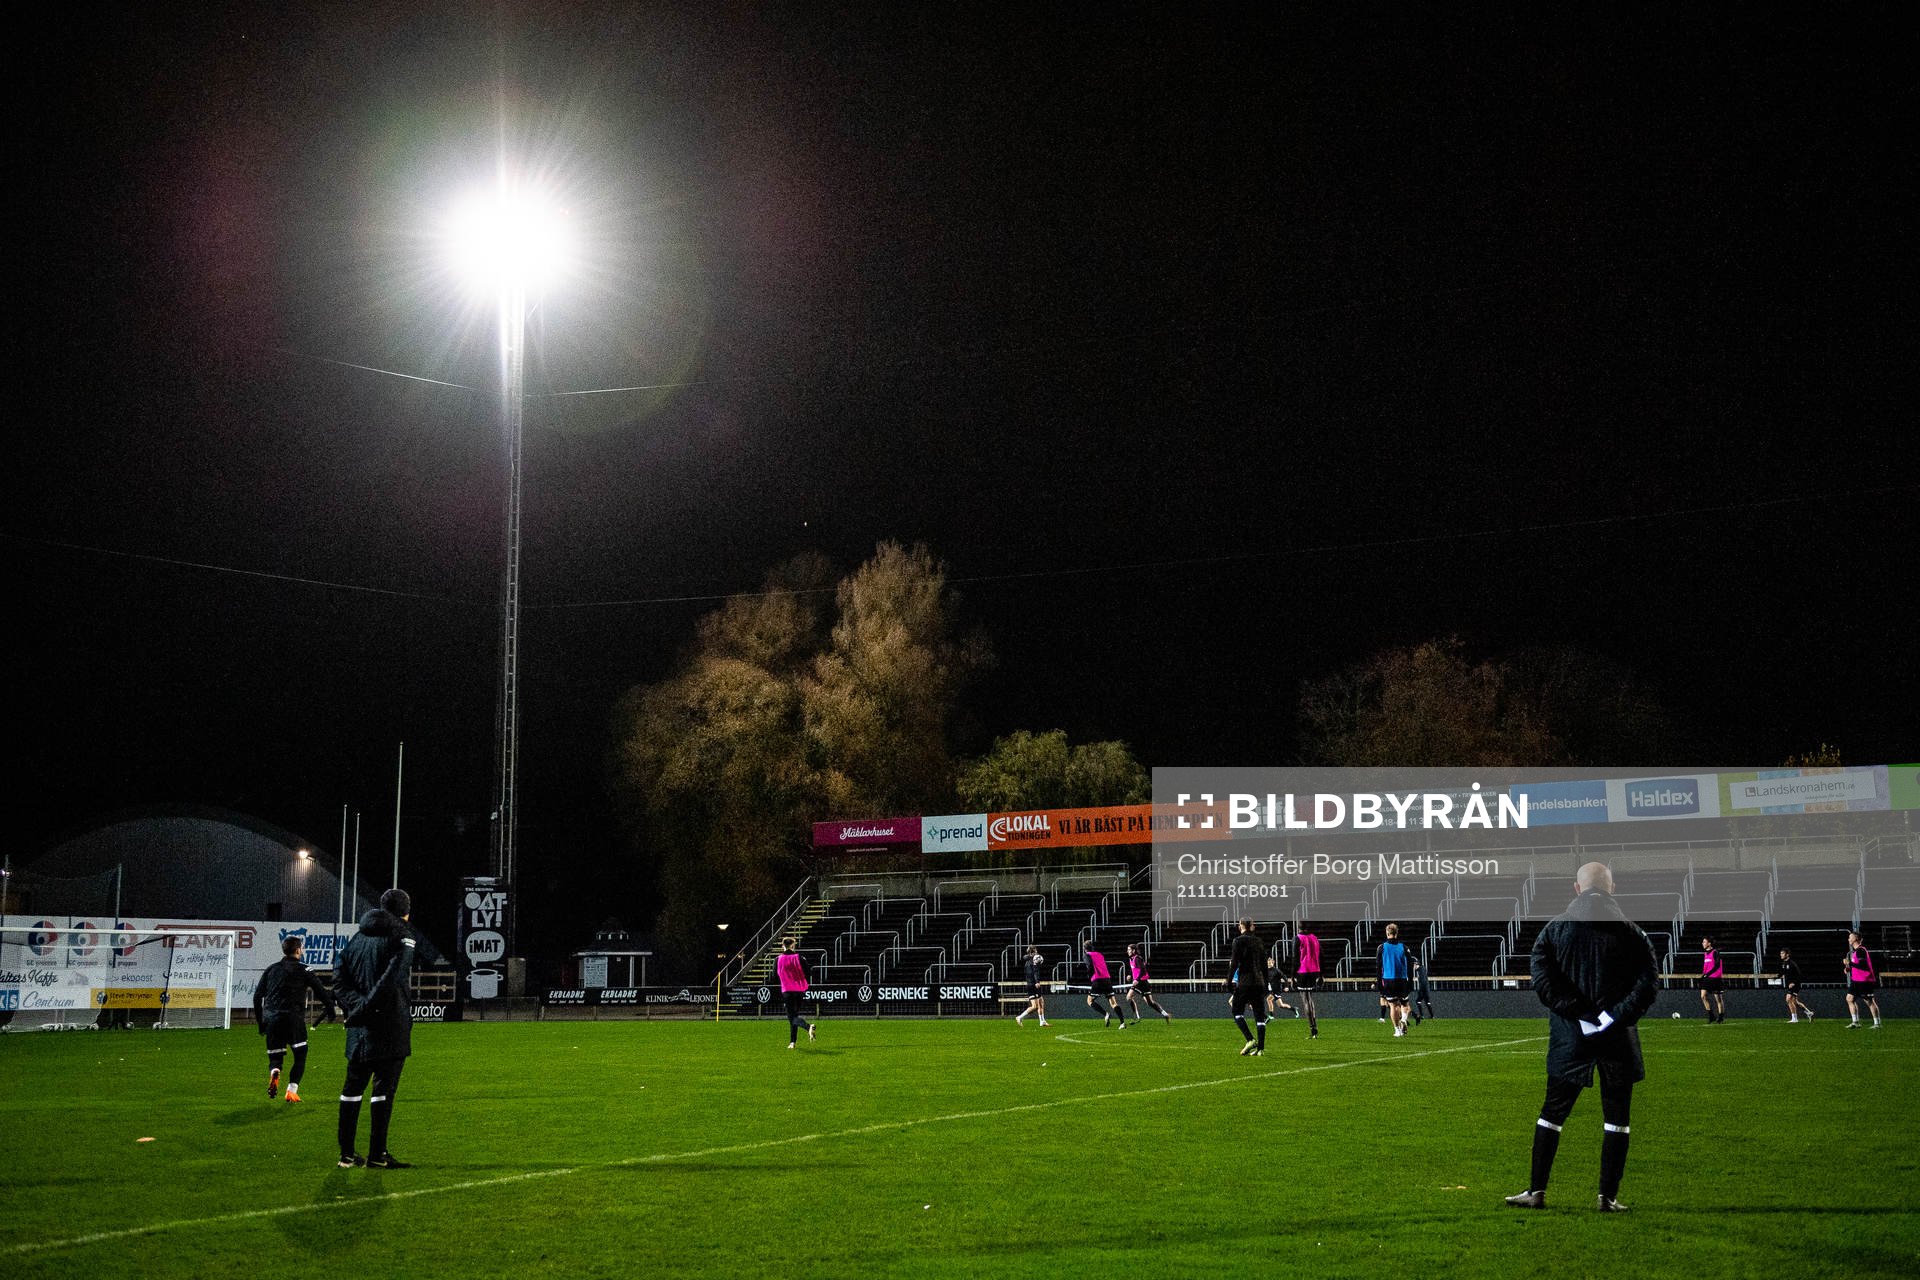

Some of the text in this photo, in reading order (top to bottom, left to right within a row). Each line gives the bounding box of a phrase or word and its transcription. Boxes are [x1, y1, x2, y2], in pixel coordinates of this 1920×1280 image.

[1631, 789, 1694, 807] Haldex
[1006, 815, 1050, 832] LOKAL
[1059, 819, 1070, 834] VI
[1075, 816, 1091, 834] ÄR
[1095, 815, 1124, 833] BÄST
[1128, 814, 1145, 832] PÅ
[840, 827, 895, 840] Mäklarhuset
[940, 824, 982, 842] prenad
[1008, 831, 1050, 841] TIDNINGEN
[472, 910, 502, 928] LY!
[470, 940, 500, 953] iMAT
[305, 950, 330, 964] TELE
[173, 972, 212, 980] PARAJETT
[803, 988, 848, 1002] swagen
[878, 987, 928, 1000] SERNEKE
[940, 986, 992, 999] SERNEKE
[22, 991, 75, 1009] Centrum
[409, 1003, 447, 1017] urator
